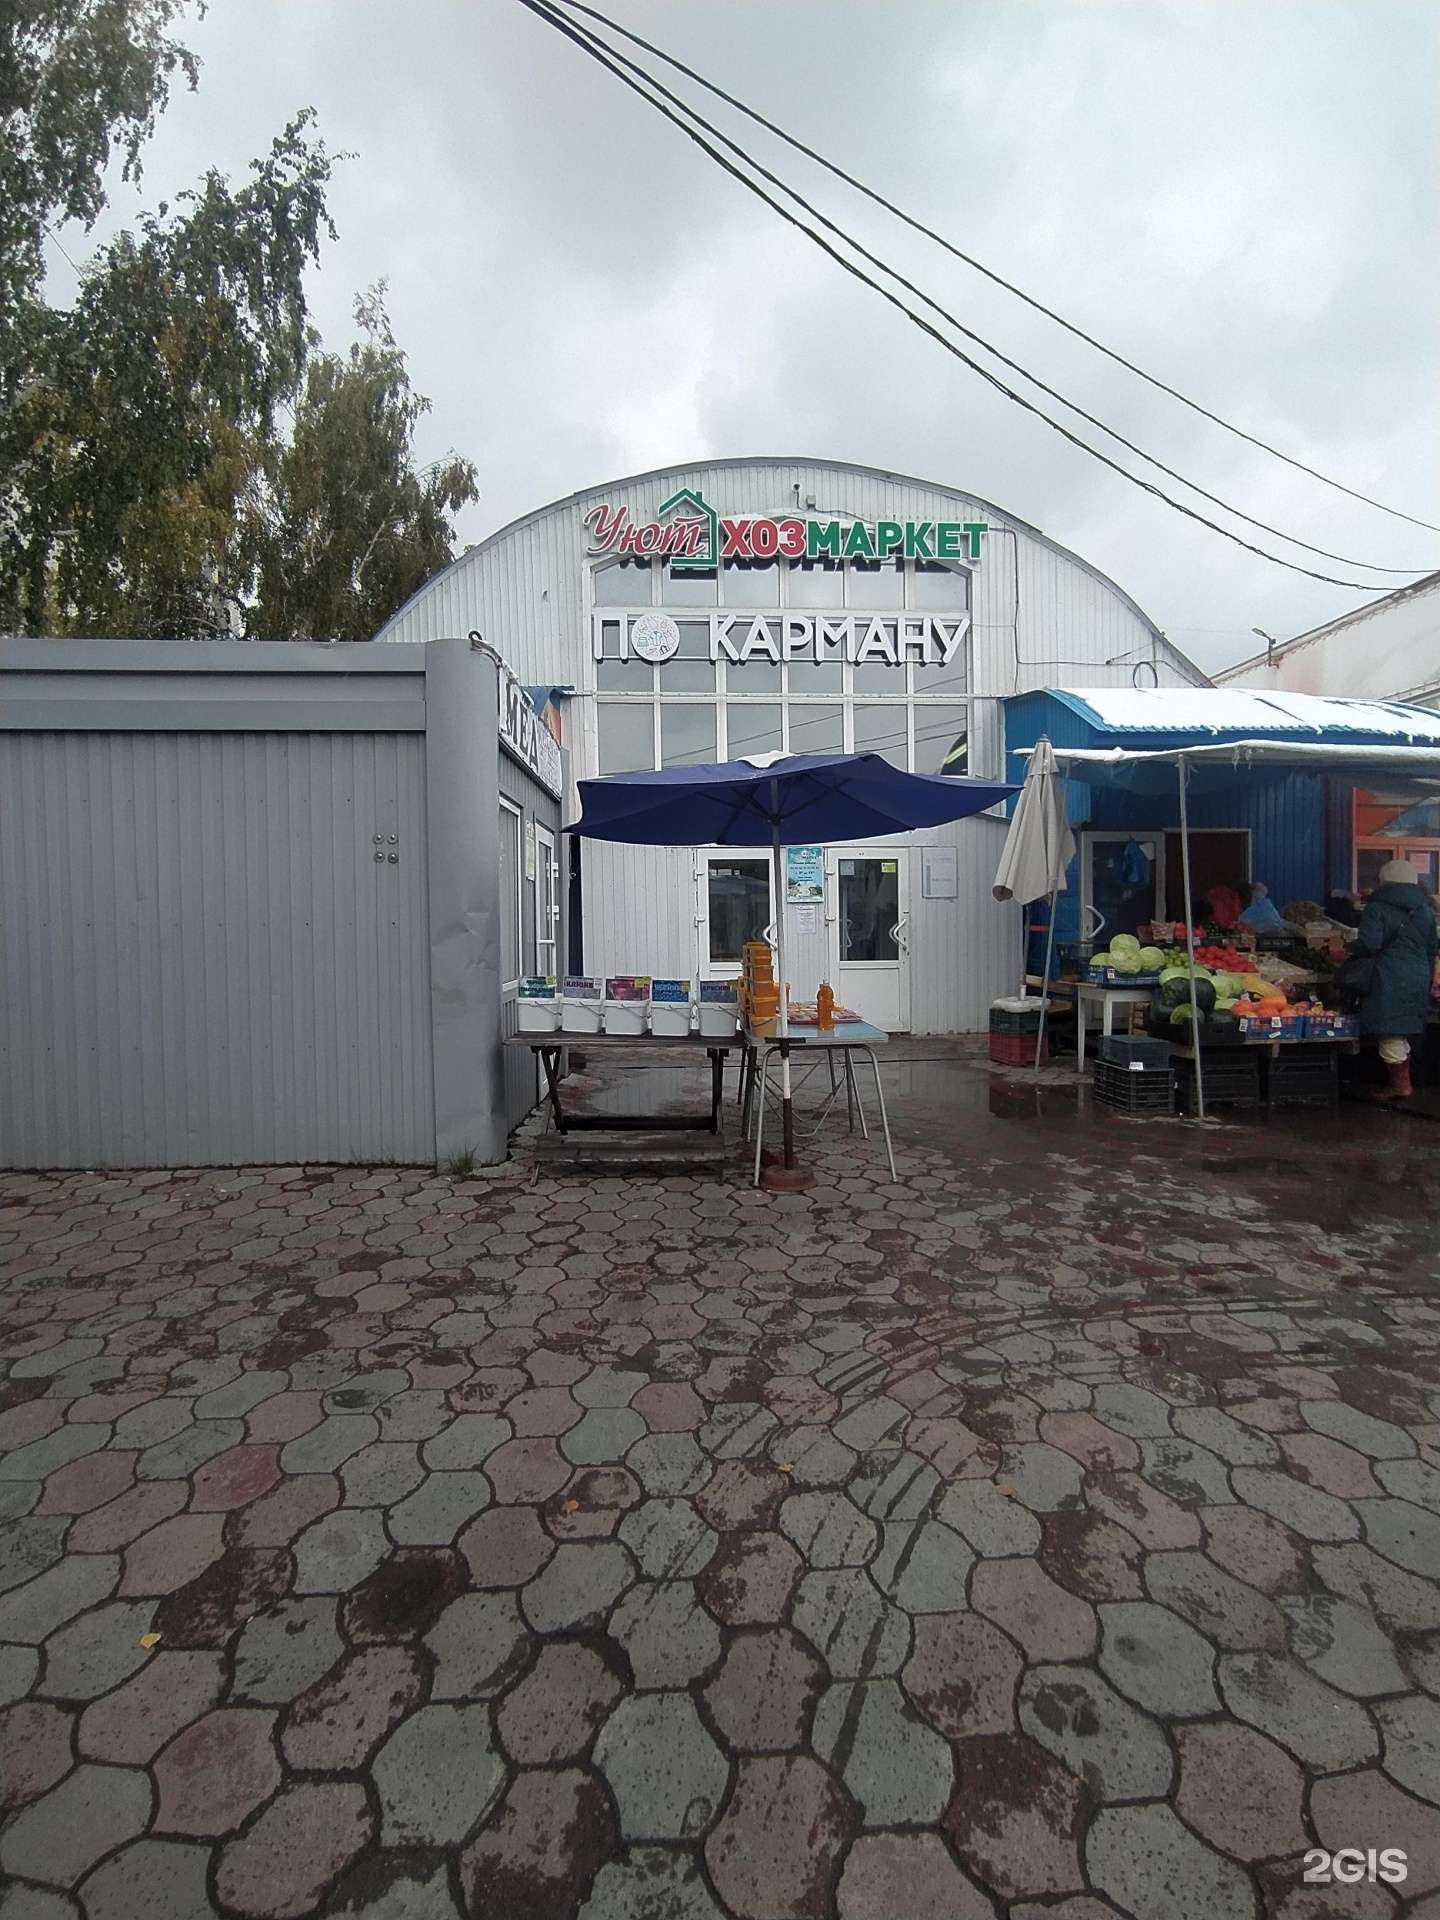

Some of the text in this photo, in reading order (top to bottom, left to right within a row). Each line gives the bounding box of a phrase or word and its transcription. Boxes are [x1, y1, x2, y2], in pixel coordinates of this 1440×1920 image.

[583, 503, 989, 560] Уют ХОЗМАРКЕТ
[709, 614, 970, 664] КАРМАНУ
